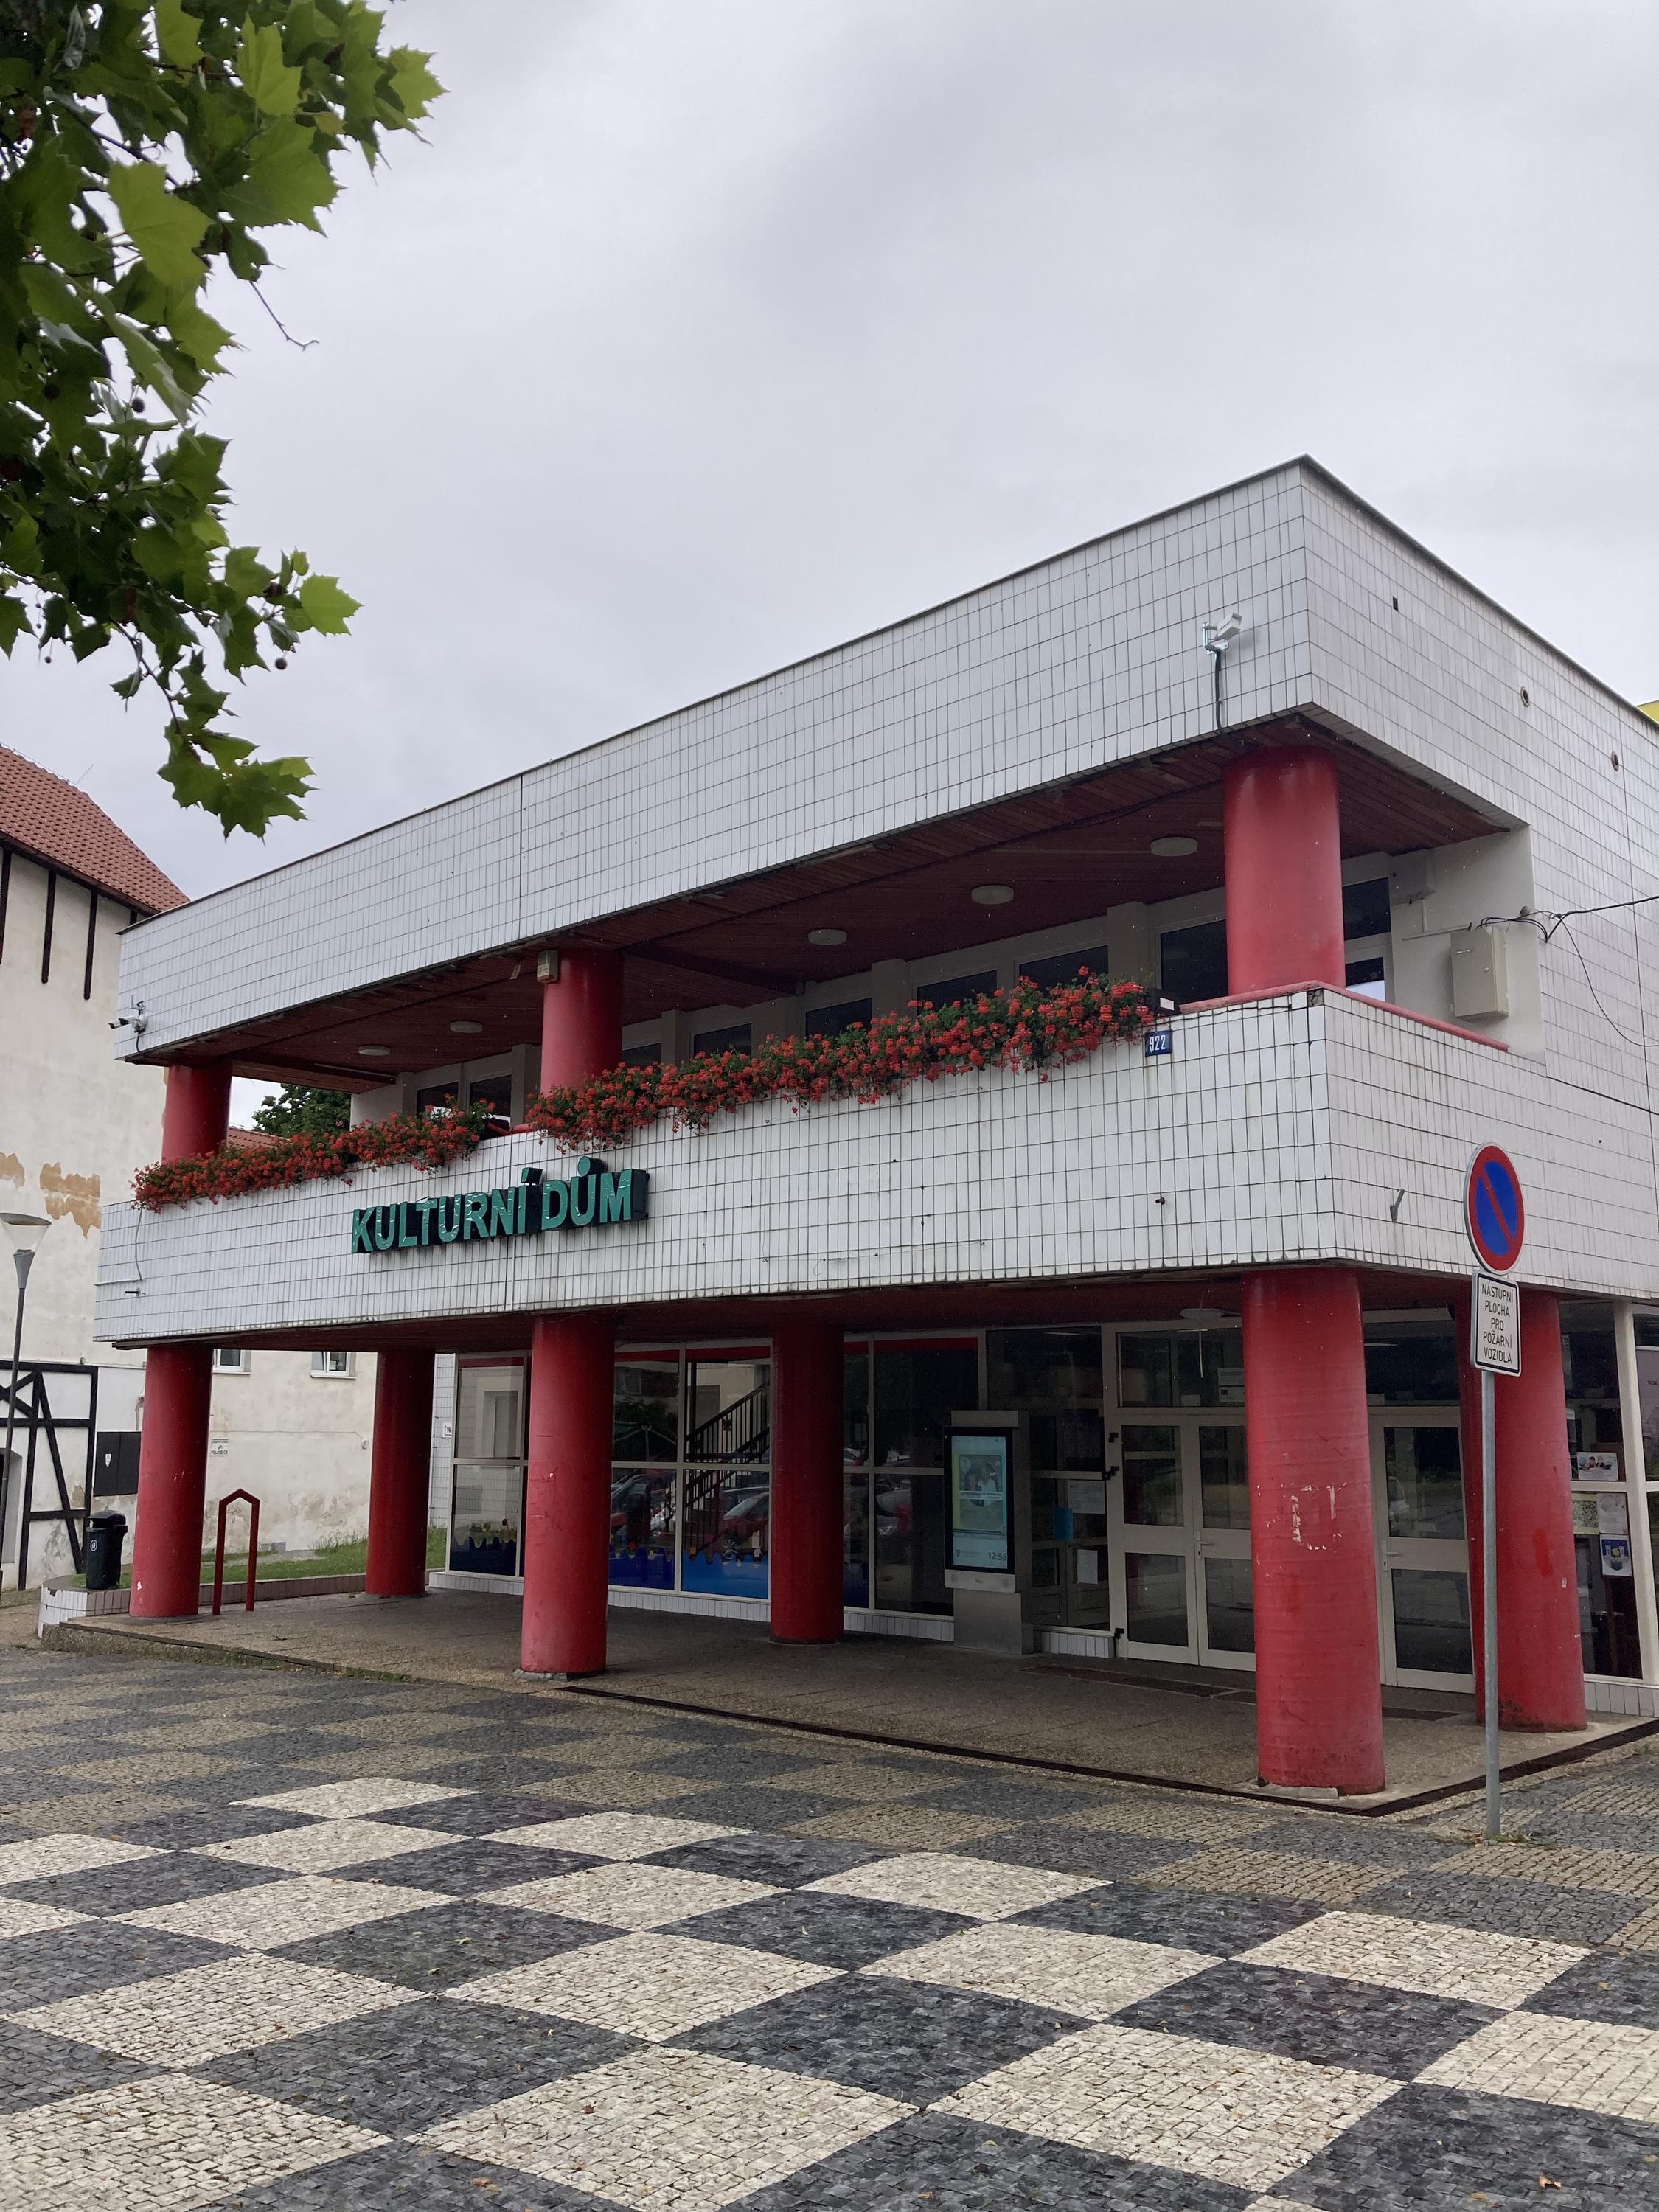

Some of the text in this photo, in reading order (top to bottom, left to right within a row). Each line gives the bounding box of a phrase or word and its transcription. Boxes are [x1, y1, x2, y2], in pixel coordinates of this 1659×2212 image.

[1150, 1034, 1166, 1051] 922
[352, 1156, 633, 1253] KULTURNÍ DŮM
[1482, 1281, 1513, 1303] NÁSTUPNÍ
[1485, 1300, 1510, 1318] PLOCHA
[1491, 1317, 1504, 1331] PRO
[1483, 1330, 1512, 1349] POŽÁRNÍ
[1484, 1346, 1512, 1364] VOZIDLA
[987, 1552, 1007, 1561] 12:58
